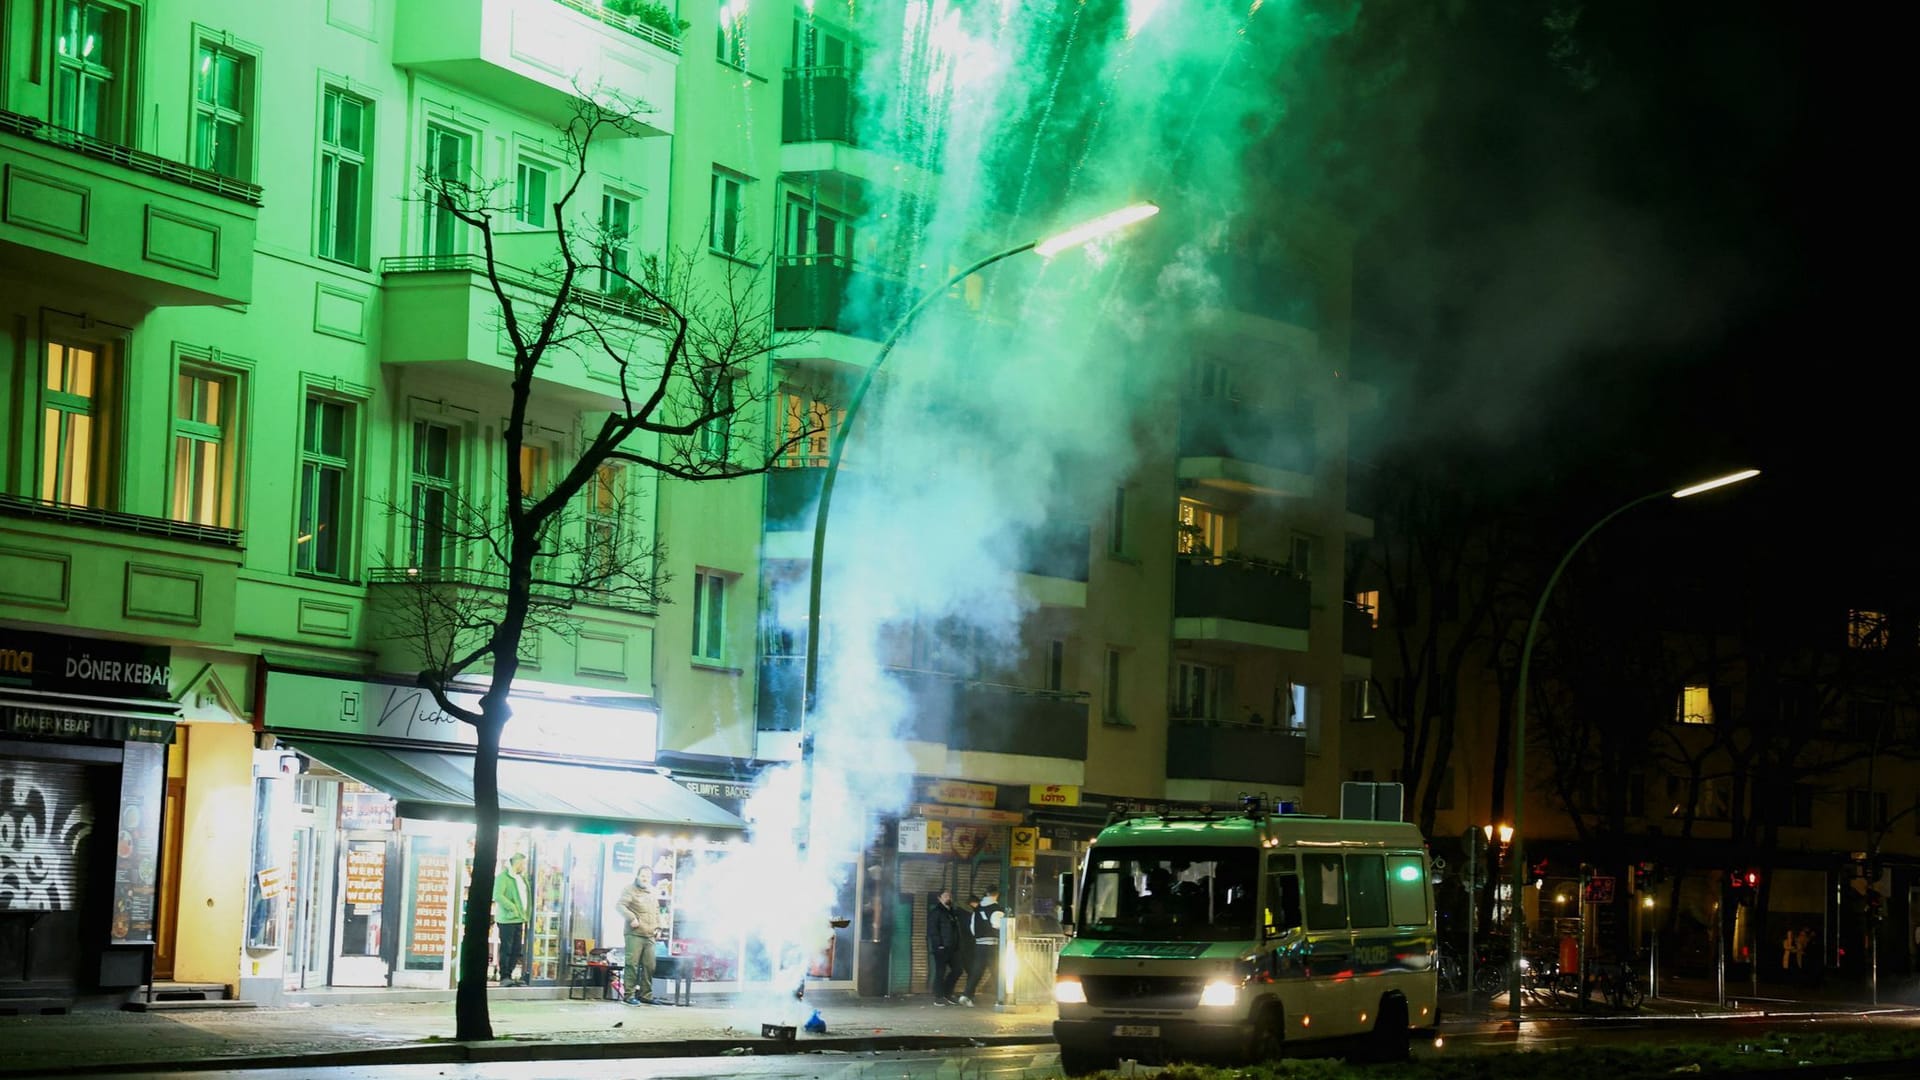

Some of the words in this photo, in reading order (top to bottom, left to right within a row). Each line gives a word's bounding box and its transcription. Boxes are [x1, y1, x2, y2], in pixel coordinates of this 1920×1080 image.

[65, 653, 121, 681] DÖNER
[124, 663, 172, 686] KEBAP
[15, 713, 53, 730] DÖNER
[55, 717, 92, 733] KEBAP
[1041, 794, 1066, 803] LOTTO
[347, 892, 382, 901] WERK
[1101, 944, 1198, 955] POLIZEI
